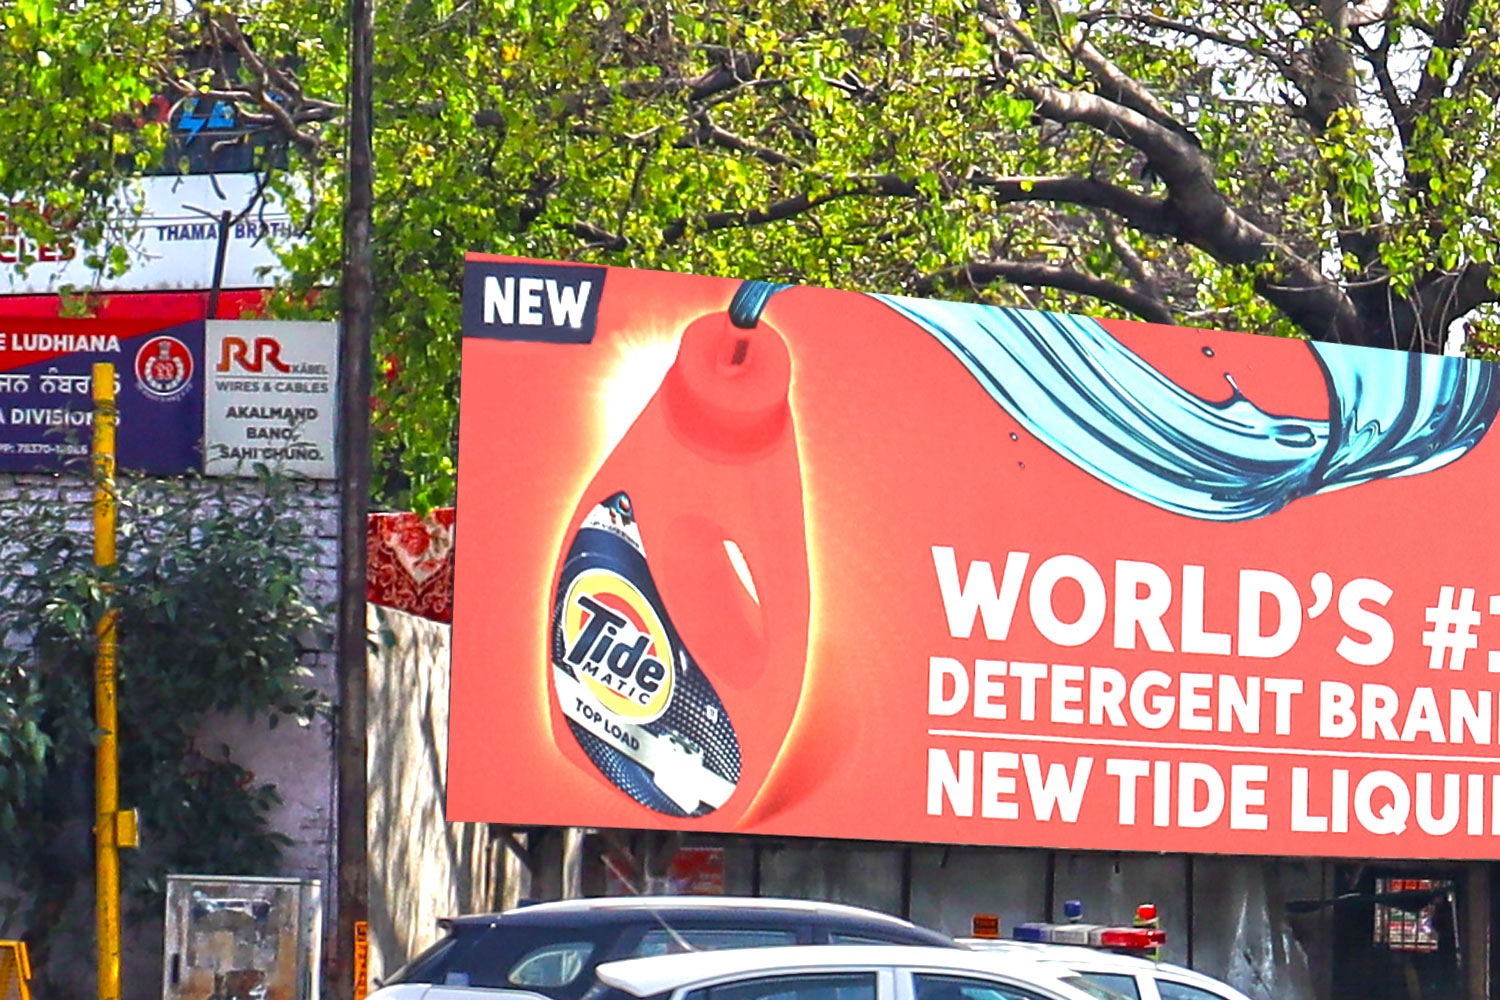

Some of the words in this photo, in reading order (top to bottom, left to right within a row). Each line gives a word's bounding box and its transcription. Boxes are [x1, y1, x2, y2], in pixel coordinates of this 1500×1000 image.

[156, 223, 220, 242] THAMA
[484, 275, 592, 328] NEW
[12, 333, 121, 352] LUDHIANA
[216, 336, 291, 373] RR
[215, 381, 259, 392] WIRES
[262, 381, 271, 392] &
[274, 382, 329, 393] CABLES
[226, 406, 318, 420] AKALMAND
[931, 544, 1395, 666] WORLD'S
[567, 595, 665, 694] Tide
[582, 662, 651, 706] MATIC
[927, 655, 1303, 736] DETERGENT
[575, 697, 603, 725] TOP
[604, 721, 641, 752] LOAD
[926, 748, 1094, 823] NEW
[1106, 758, 1269, 831] TIDE
